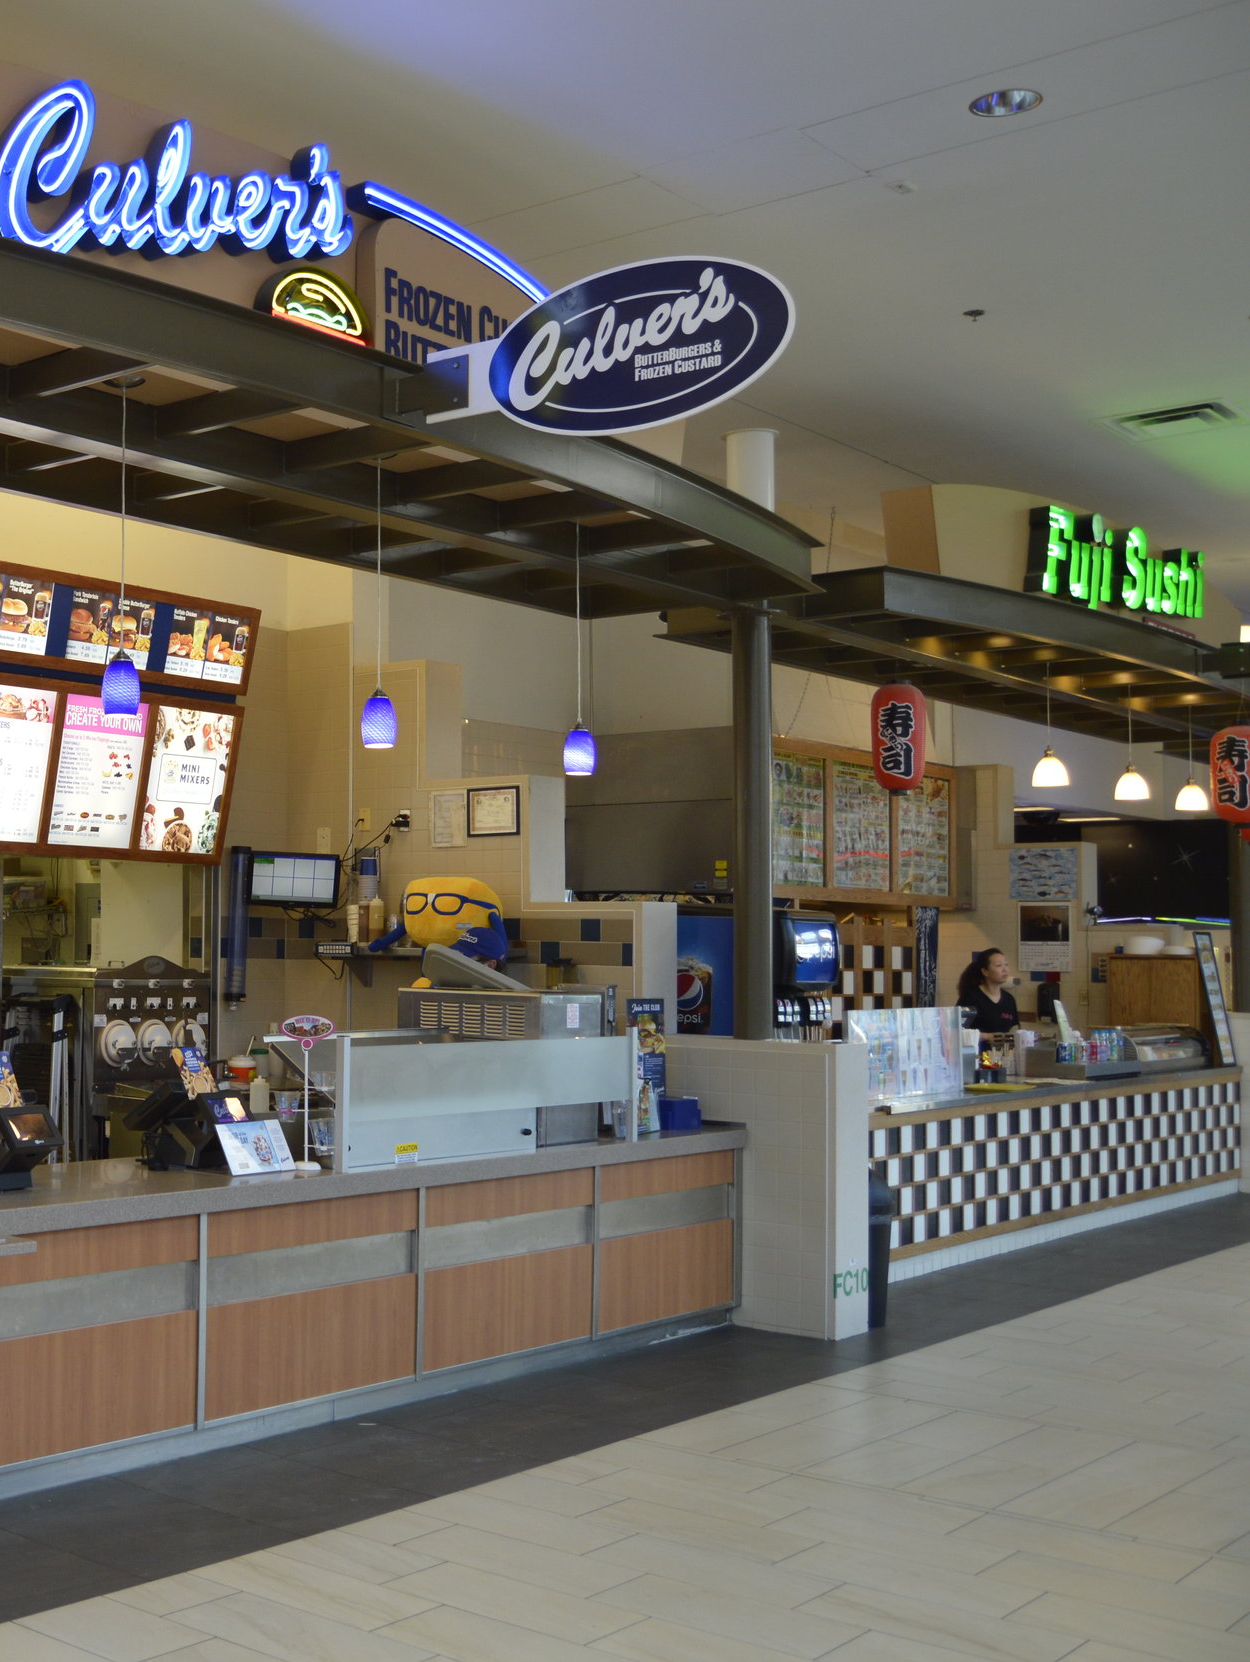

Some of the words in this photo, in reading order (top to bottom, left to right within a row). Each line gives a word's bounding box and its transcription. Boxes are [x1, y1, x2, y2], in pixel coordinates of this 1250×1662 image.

[384, 267, 472, 344] FROZEN
[508, 267, 735, 412] Culver's
[713, 339, 722, 352] &
[634, 364, 674, 382] FROZEN
[674, 354, 722, 377] CUSTARD
[1041, 505, 1113, 610] Fuji
[1121, 527, 1205, 618] Sushi
[67, 704, 88, 713] FRESH
[65, 711, 99, 727] CREATE
[100, 715, 121, 730] YOUR
[122, 718, 143, 734] OWN
[878, 701, 915, 779] 寿司
[180, 774, 210, 785] MIXERS
[181, 764, 200, 774] MINI
[631, 1003, 643, 1013] Join
[677, 1012, 701, 1025] epsi
[833, 1267, 869, 1299] FC10
